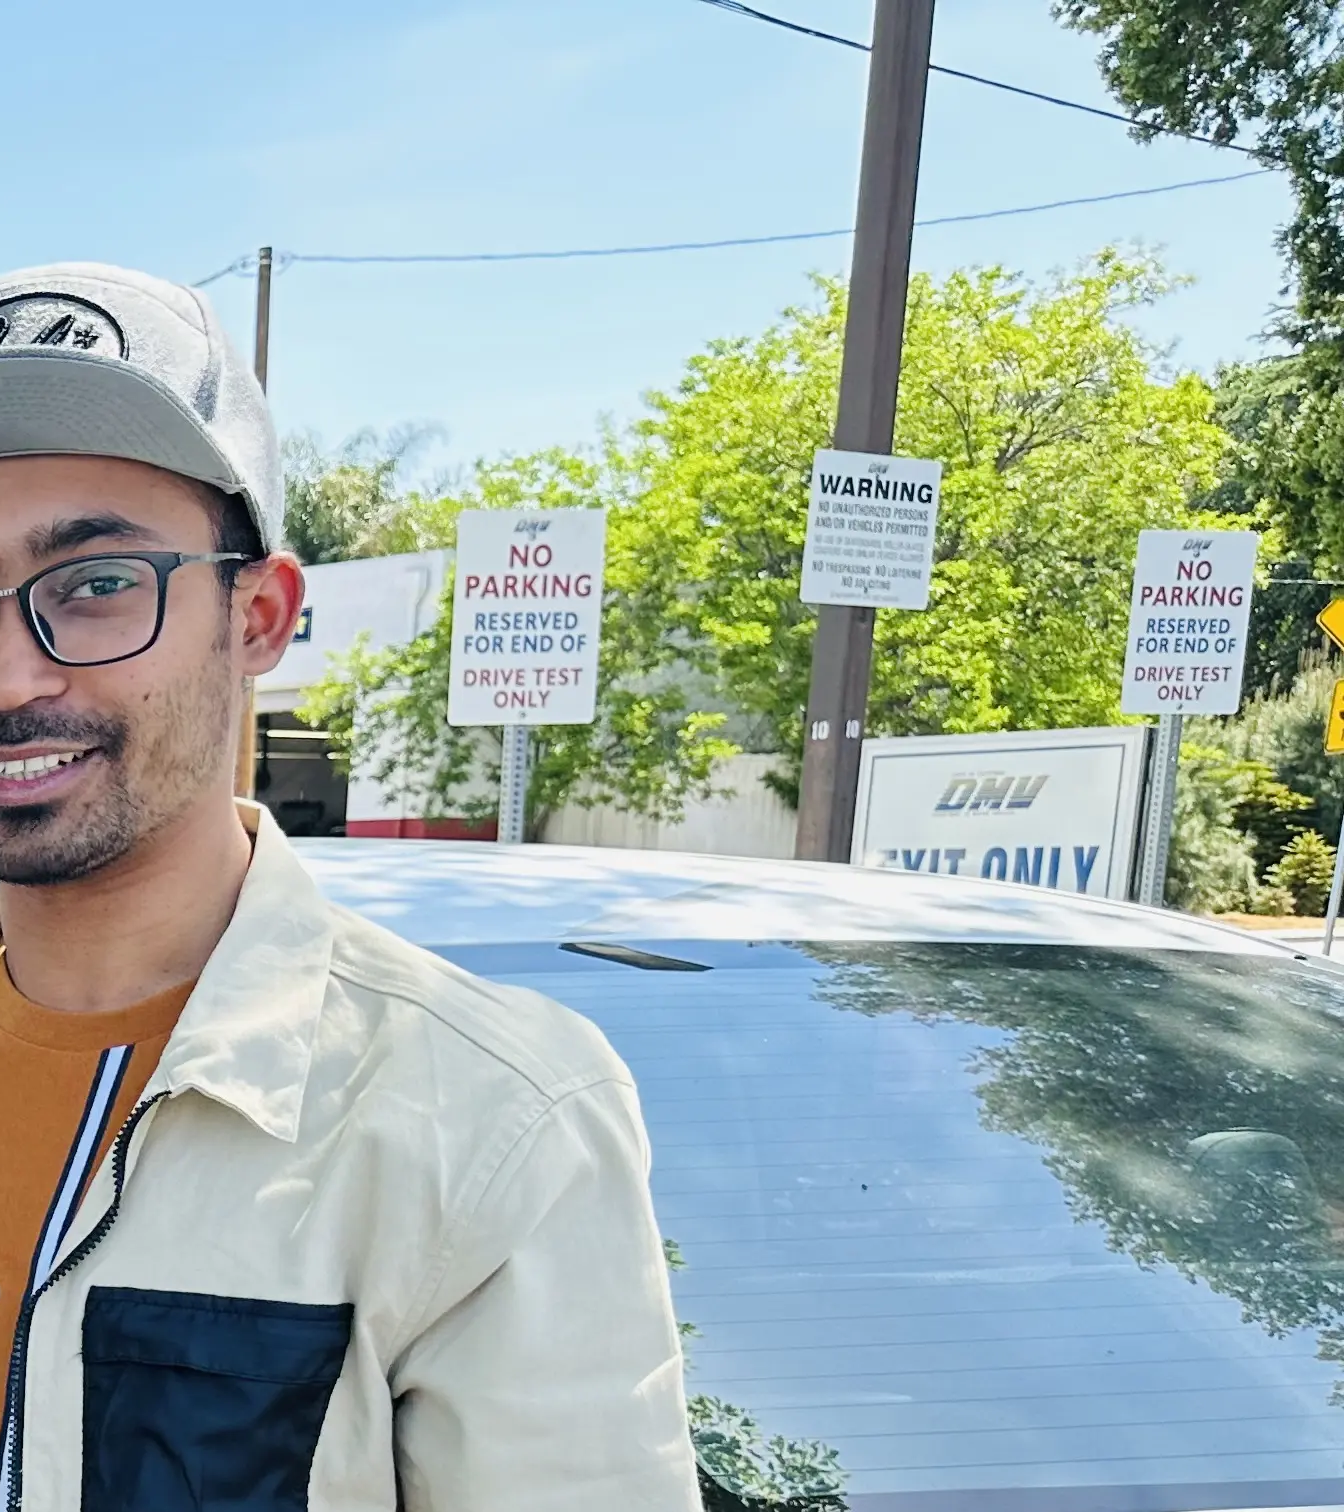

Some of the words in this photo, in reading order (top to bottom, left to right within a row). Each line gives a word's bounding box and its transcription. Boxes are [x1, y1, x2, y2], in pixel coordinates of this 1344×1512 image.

[819, 473, 933, 503] WARNING
[818, 501, 829, 513] NO
[832, 503, 891, 518] UNAUTHORIZED
[894, 507, 928, 522] PERSONS
[886, 522, 928, 537] PERMITTED
[509, 545, 552, 569] NO
[1177, 560, 1212, 581] NO
[465, 575, 592, 599] PARKING
[1140, 586, 1244, 606] PARKING
[475, 612, 578, 631] RESERVED
[1146, 618, 1230, 634] RESERVED
[464, 636, 503, 654] FOR
[512, 635, 553, 653] END
[560, 635, 587, 652] OF
[1136, 638, 1168, 653] FOR
[1174, 638, 1209, 653] END
[1214, 638, 1236, 653] OF
[463, 669, 525, 687] DRIVE
[533, 668, 583, 686] TEST
[1134, 667, 1184, 682] DRIVE
[1190, 667, 1232, 682] TEST
[494, 690, 551, 708] ONLY
[1157, 686, 1204, 700] ONLY
[812, 720, 829, 740] 10
[846, 719, 860, 739] 10
[935, 775, 1050, 811] DMV
